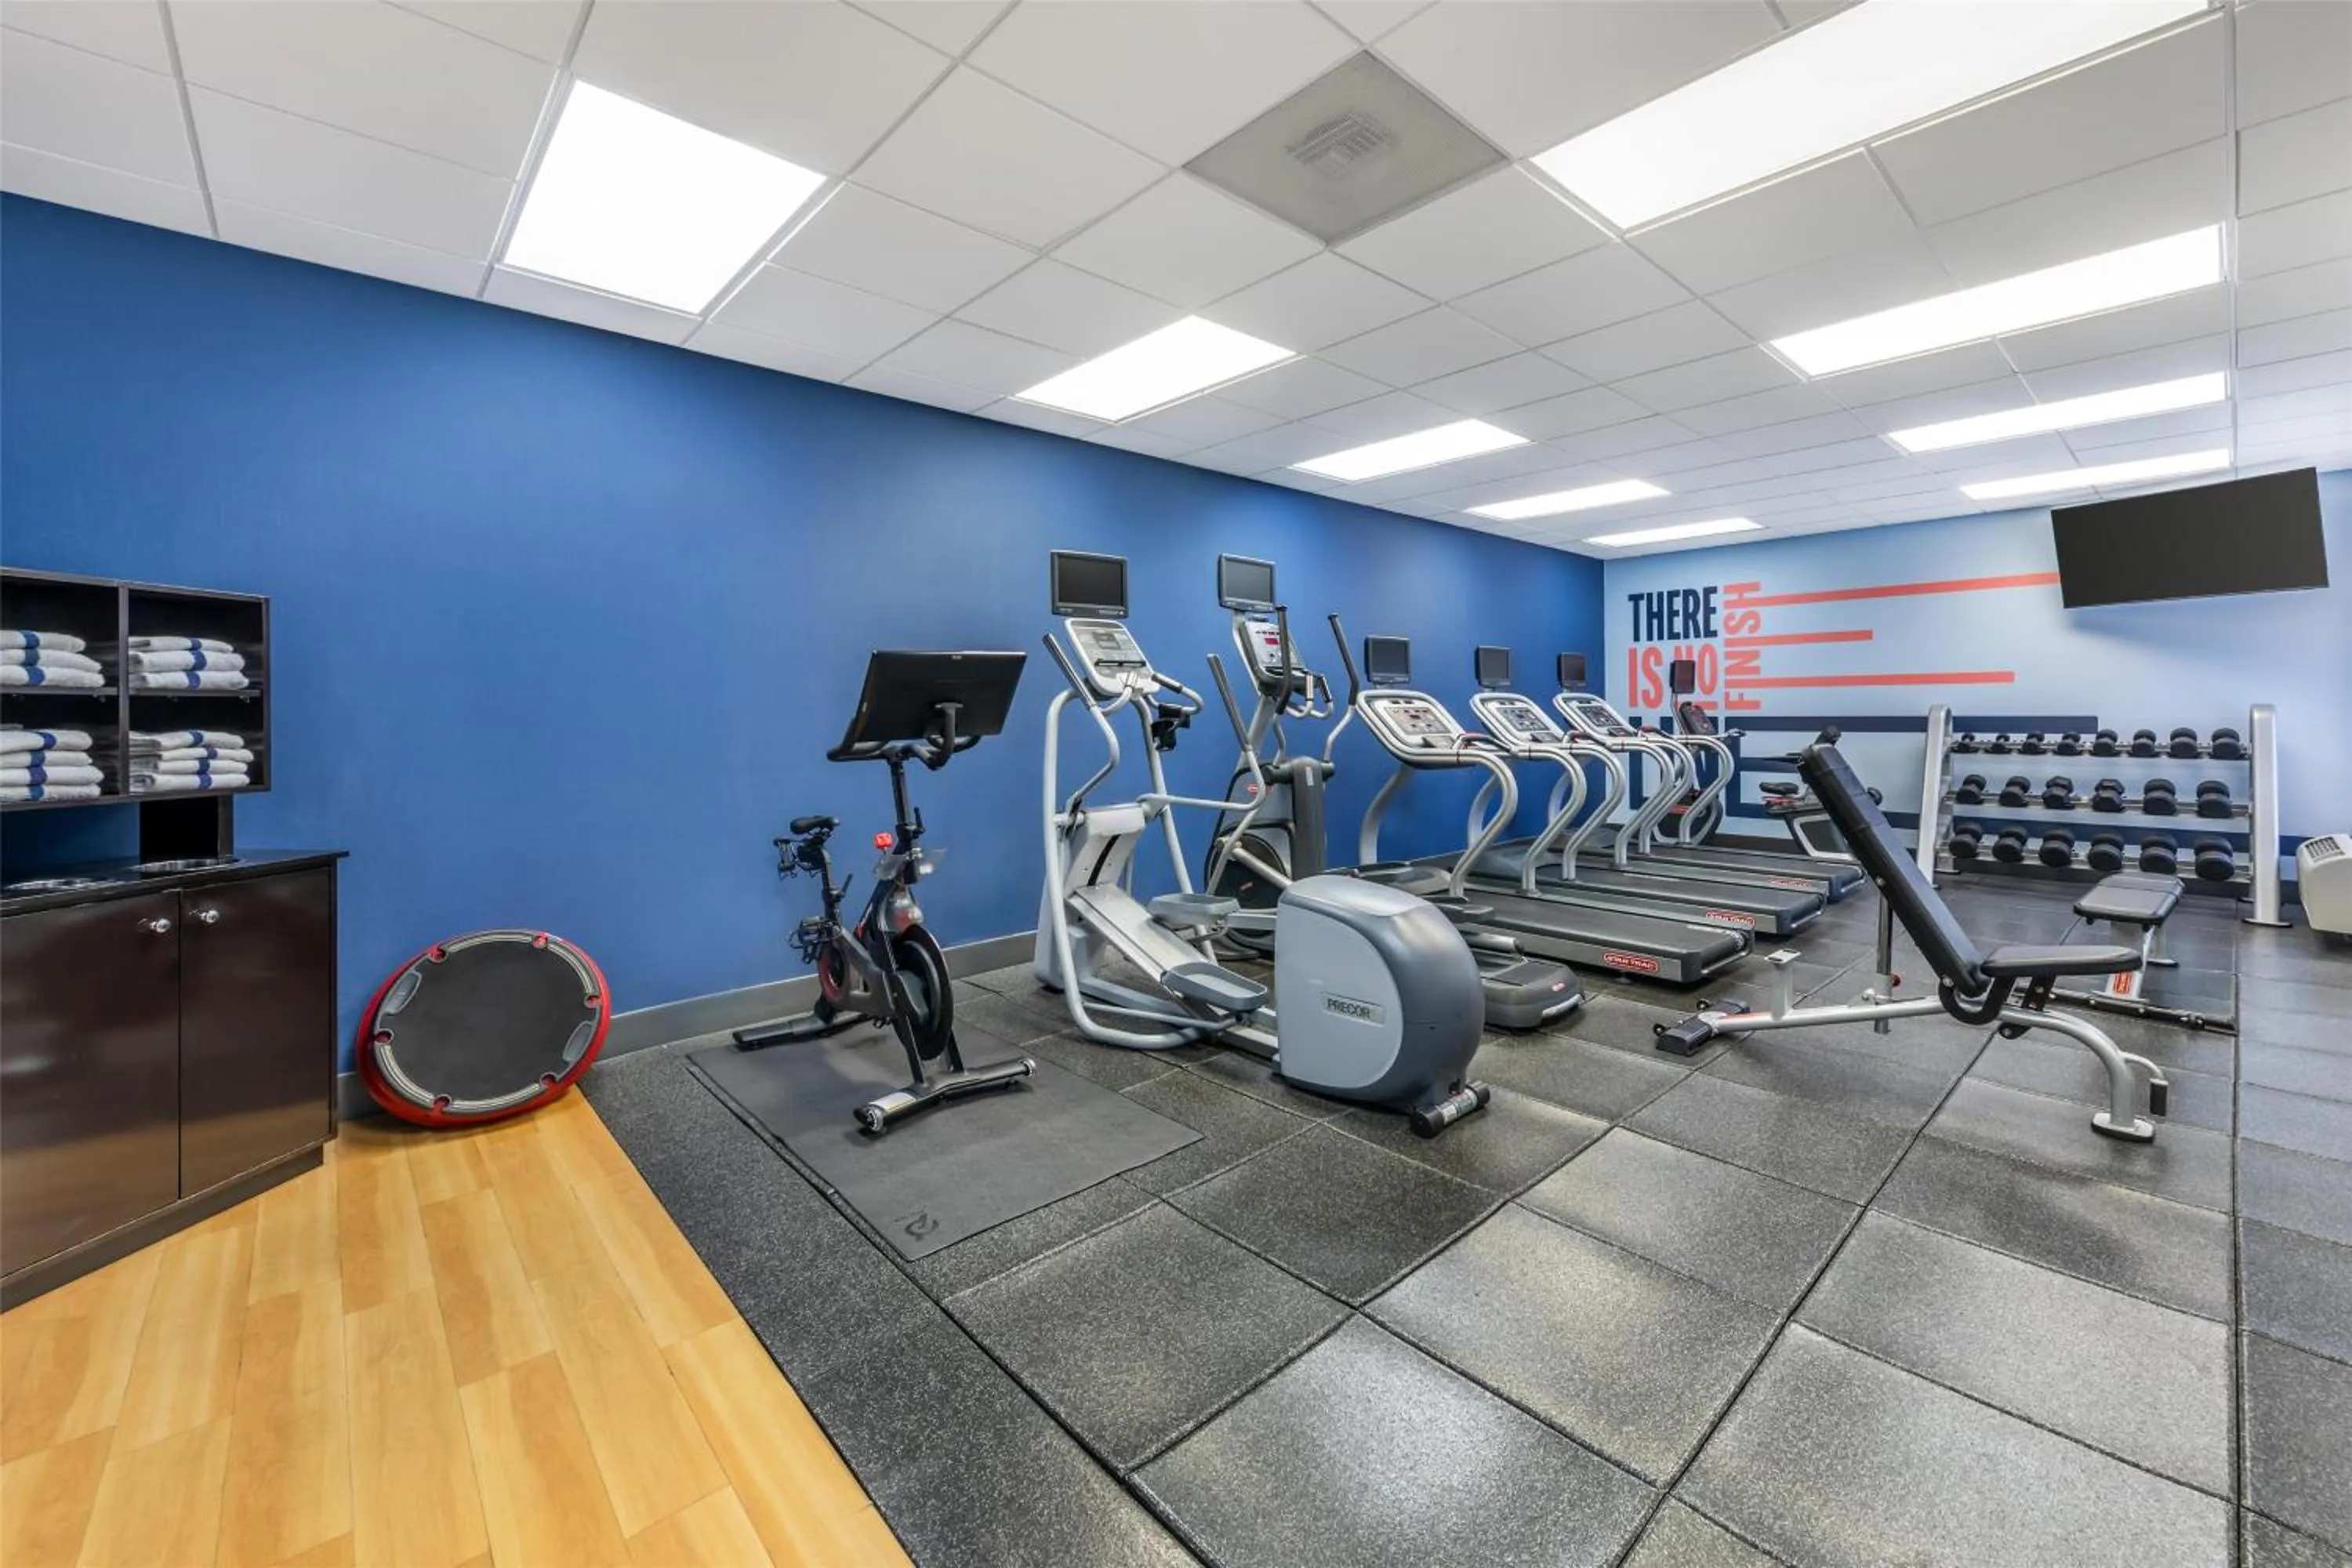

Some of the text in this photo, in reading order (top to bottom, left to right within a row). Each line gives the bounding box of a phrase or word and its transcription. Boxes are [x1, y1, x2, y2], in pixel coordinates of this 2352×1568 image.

[1628, 586, 1718, 642] THERE
[1722, 581, 1761, 710] FINISH
[1628, 645, 1664, 709] IS
[1327, 998, 1370, 1020] PRECOR
